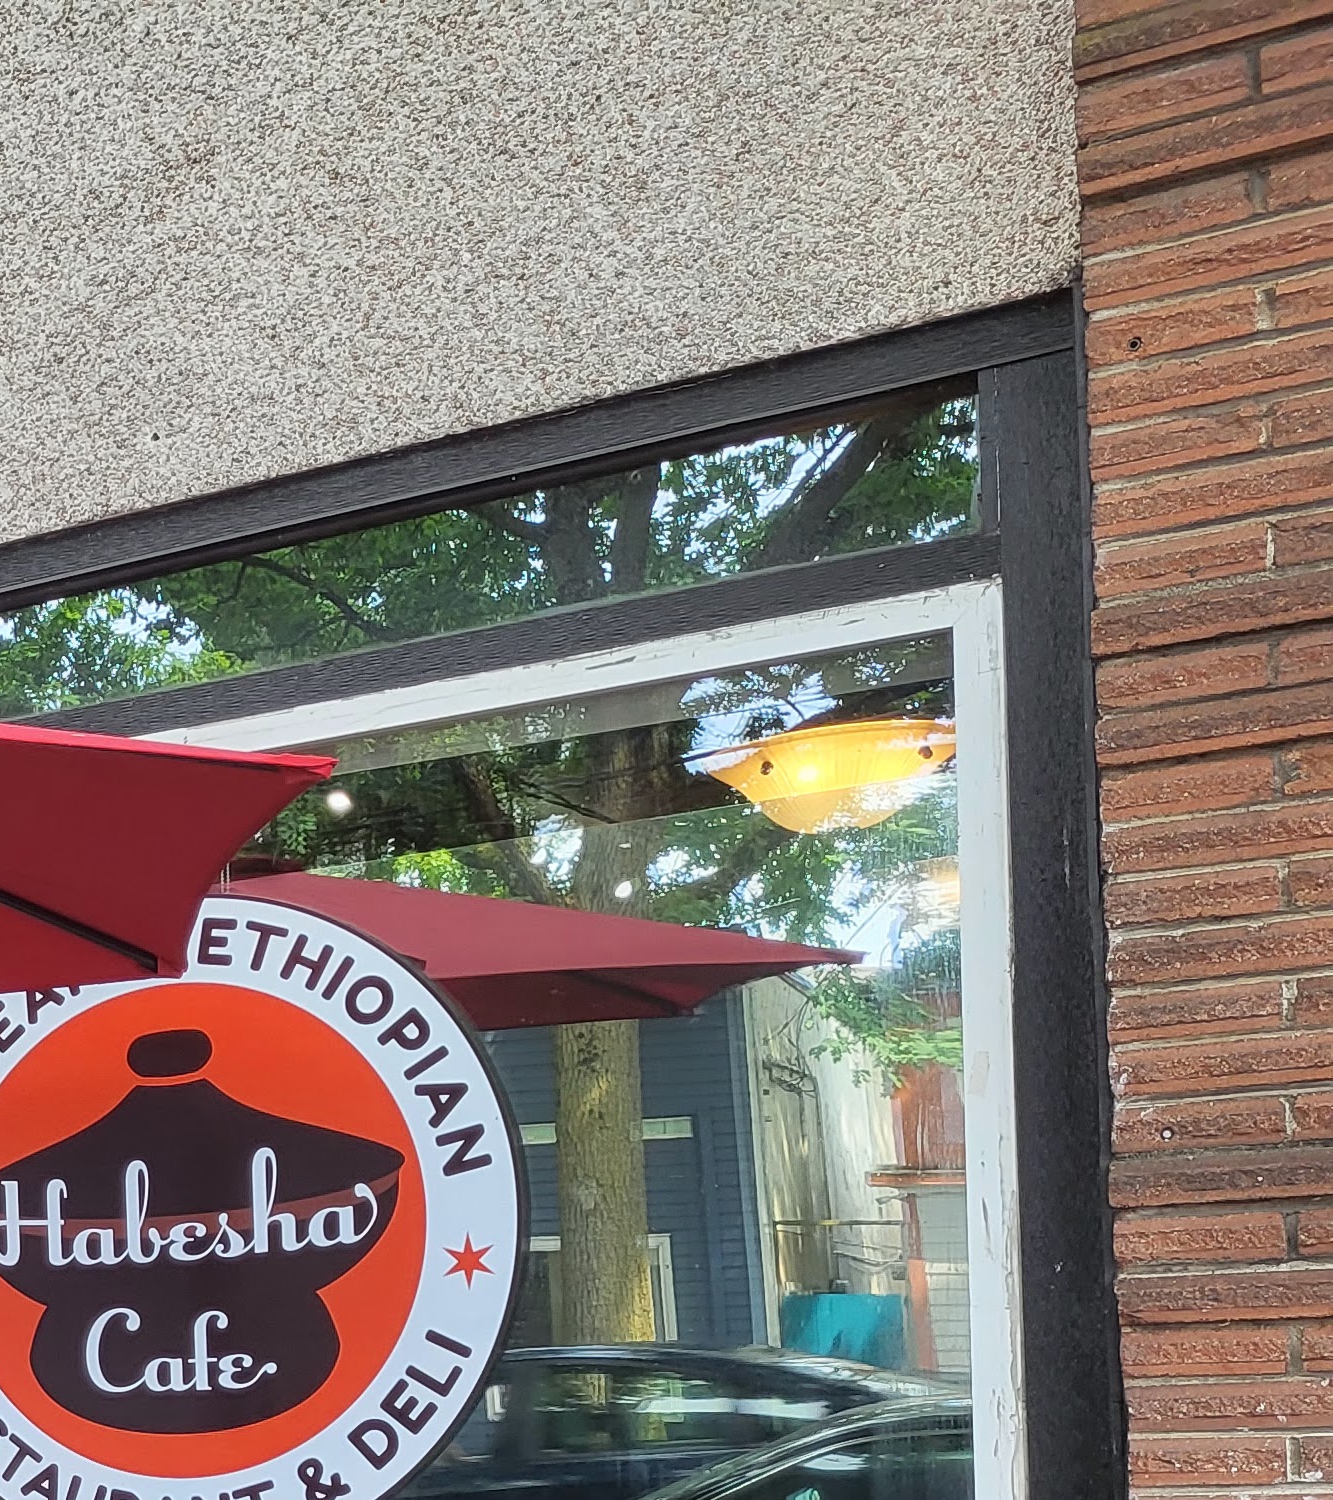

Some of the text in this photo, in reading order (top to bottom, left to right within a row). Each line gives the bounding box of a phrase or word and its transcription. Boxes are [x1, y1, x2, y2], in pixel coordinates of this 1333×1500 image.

[197, 917, 493, 1177] ETHIOPIAN
[85, 1307, 278, 1393] Cafe
[347, 1329, 473, 1470] DELI
